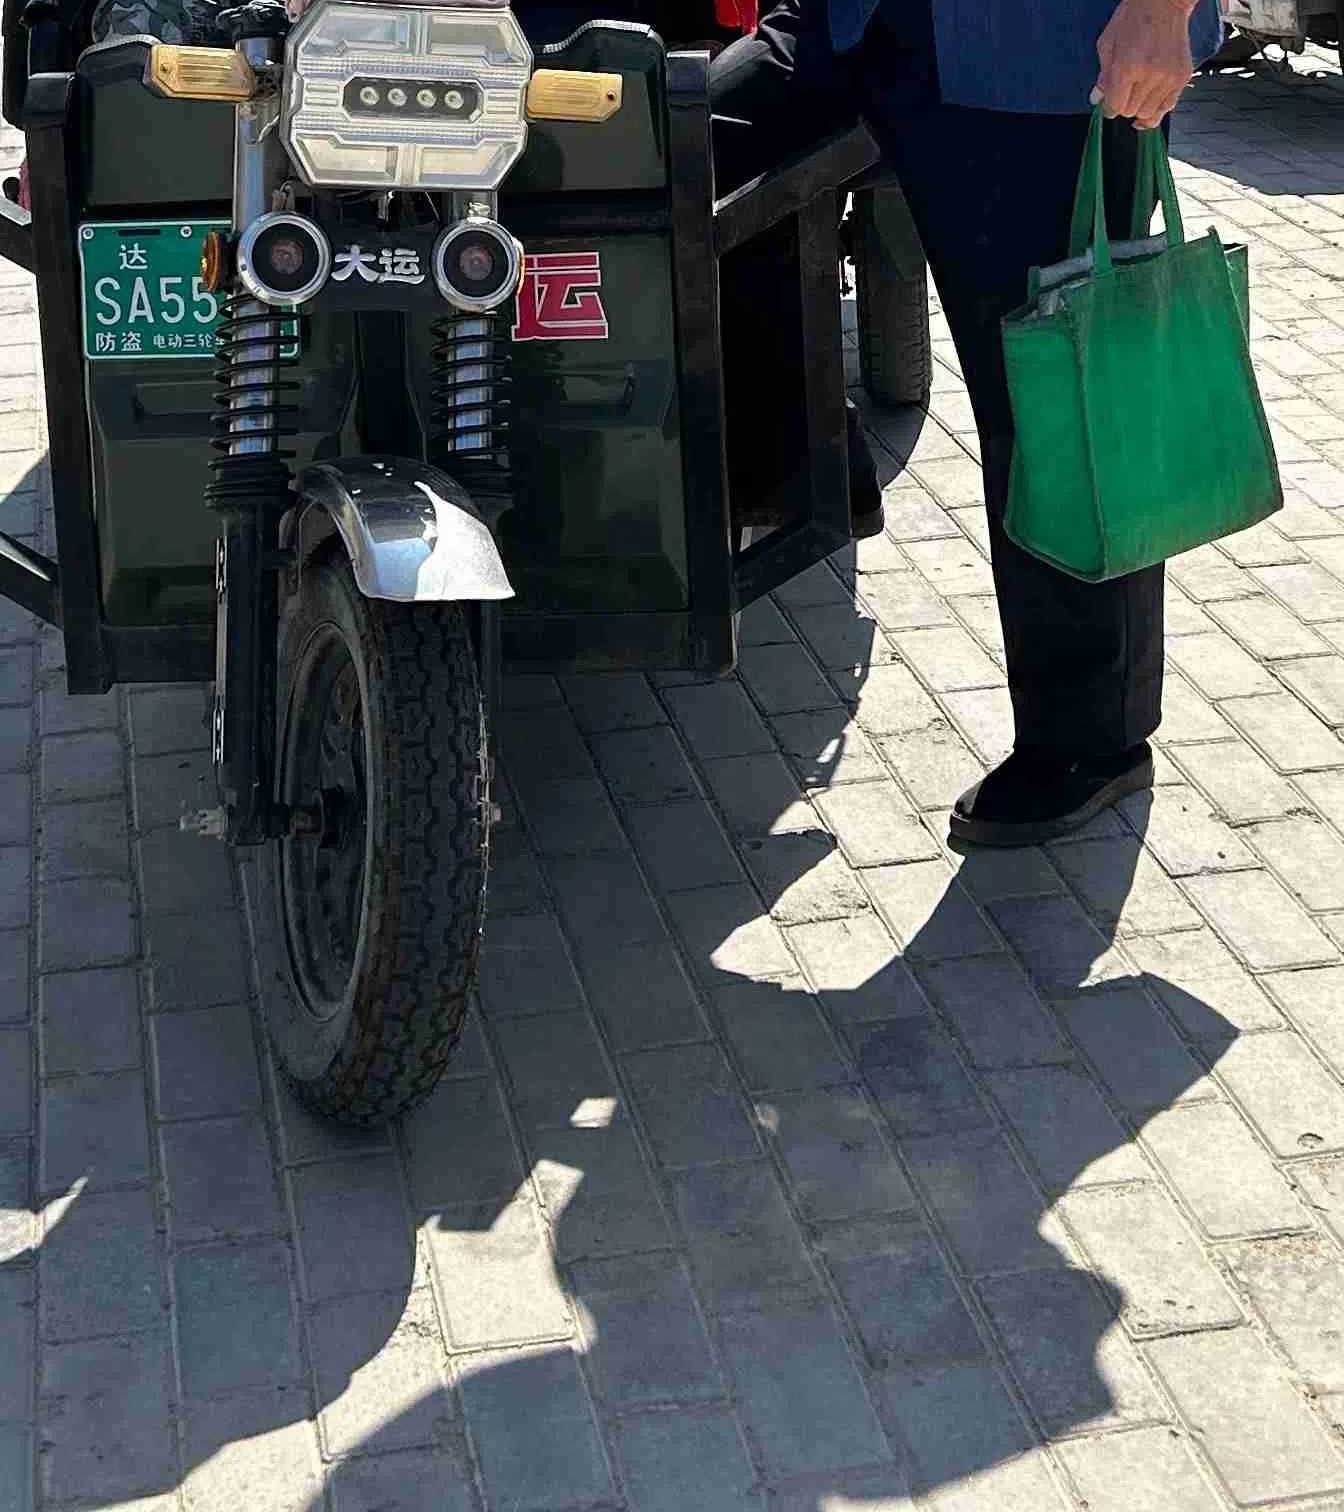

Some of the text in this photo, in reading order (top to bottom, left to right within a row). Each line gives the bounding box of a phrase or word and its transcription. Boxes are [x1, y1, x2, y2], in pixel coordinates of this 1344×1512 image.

[119, 243, 148, 270] 达
[331, 244, 425, 285] 大运
[95, 331, 142, 352] 防盗
